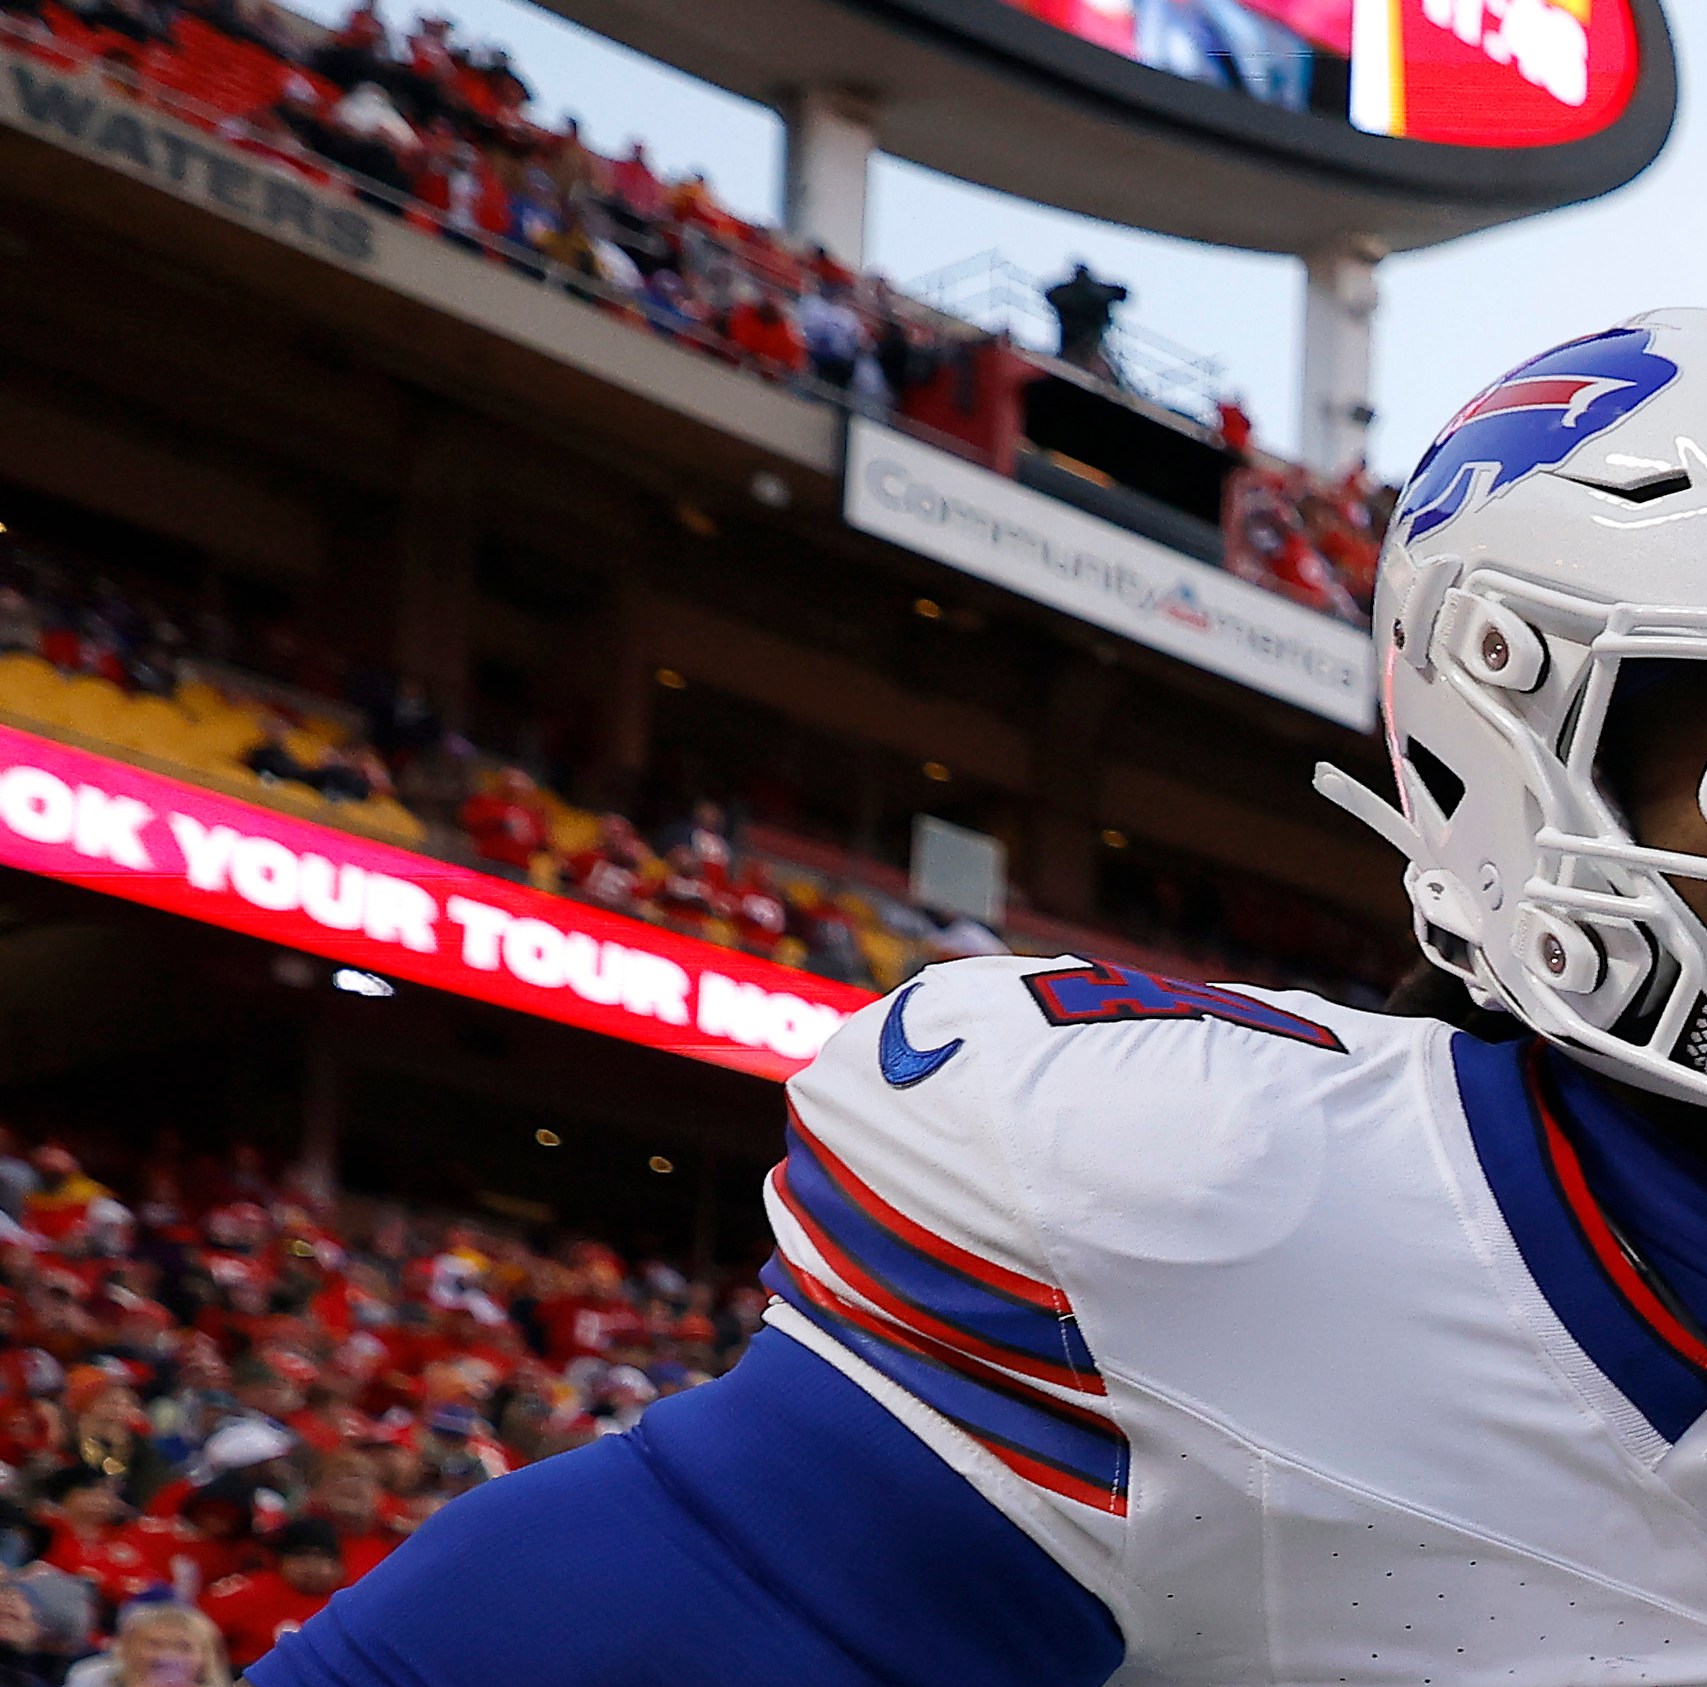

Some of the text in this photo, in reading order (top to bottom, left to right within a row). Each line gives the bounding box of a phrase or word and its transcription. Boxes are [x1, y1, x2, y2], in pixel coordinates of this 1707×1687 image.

[9, 63, 377, 259] WATERS
[167, 810, 439, 954] YOUR
[446, 892, 690, 1028] TOUR
